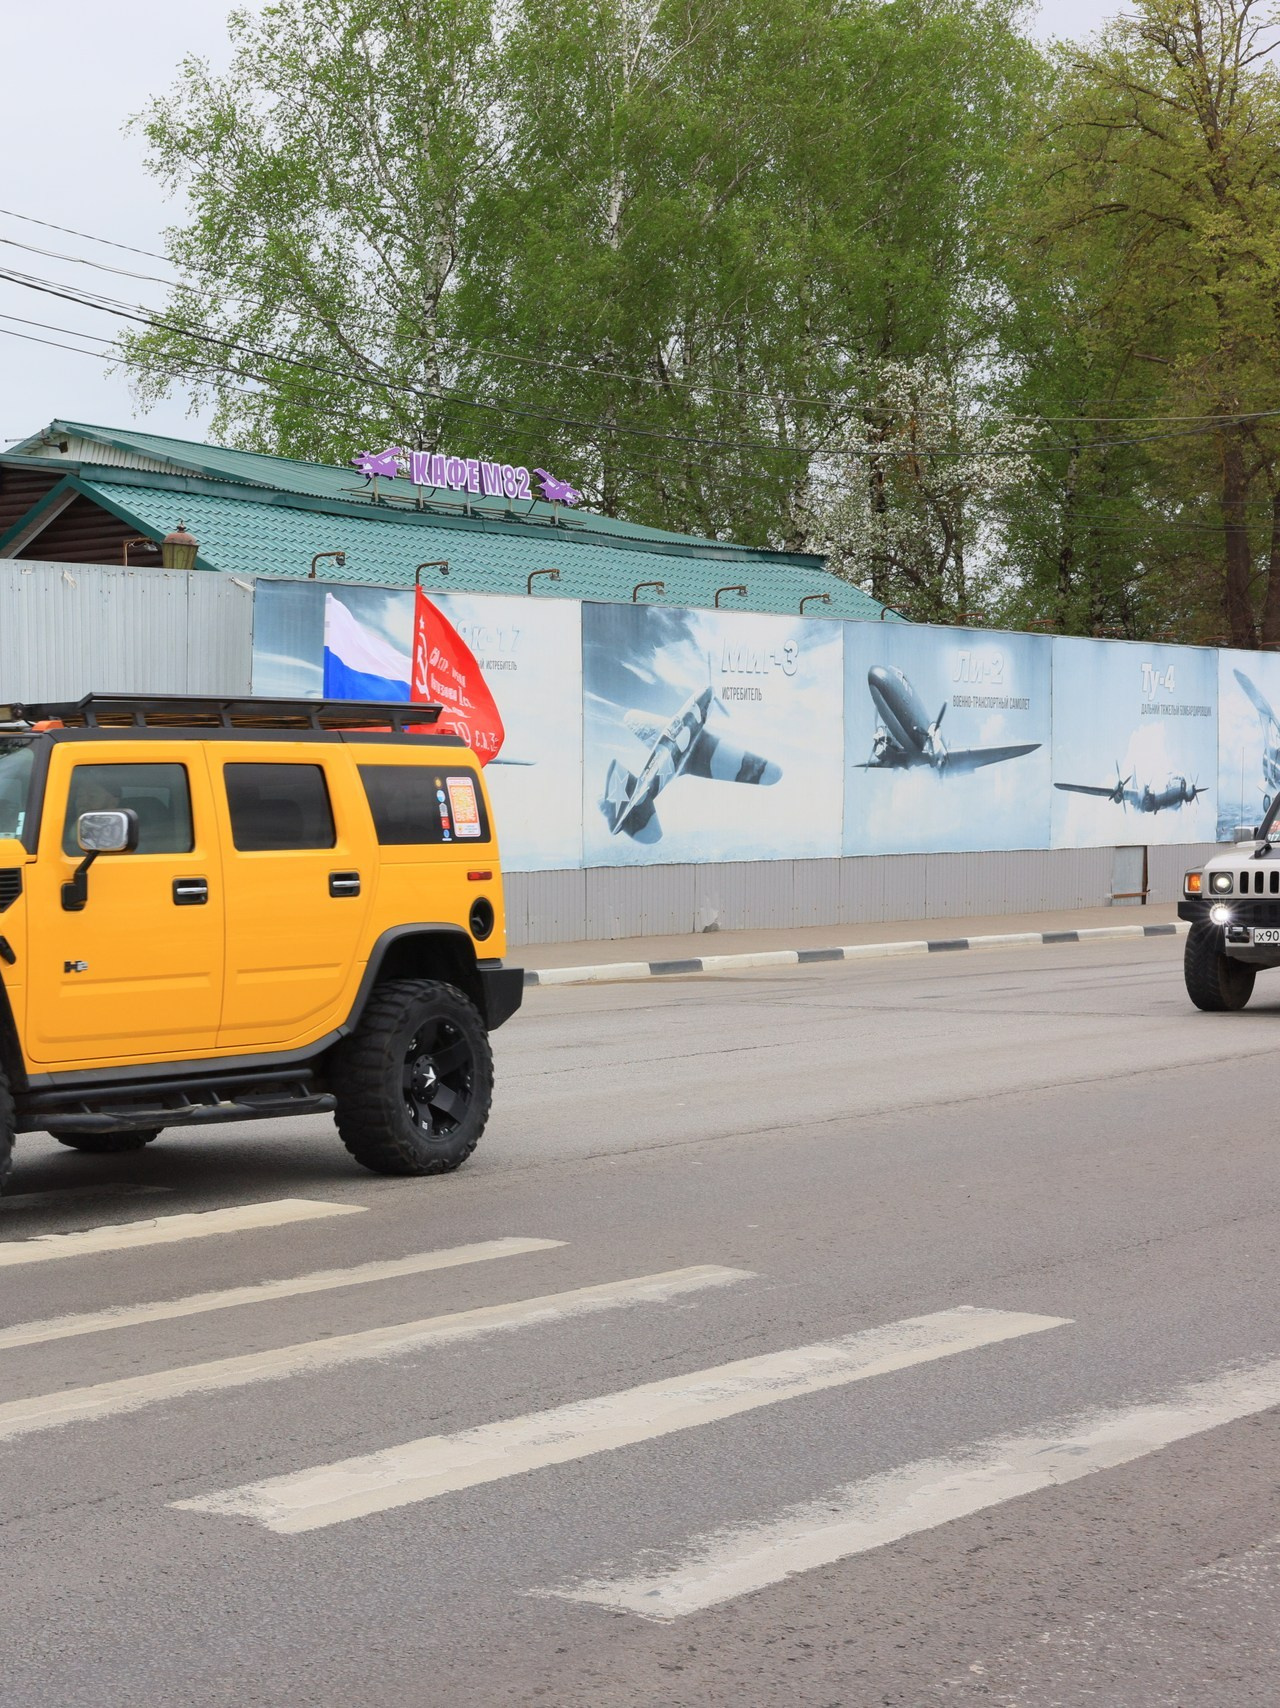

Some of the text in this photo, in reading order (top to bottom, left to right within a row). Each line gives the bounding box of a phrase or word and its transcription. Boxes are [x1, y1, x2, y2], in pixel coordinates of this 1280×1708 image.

[410, 450, 533, 500] КАФЕ М82
[486, 660, 519, 671] ИСТРЕБИТЕЛЬ
[953, 650, 1004, 685] Ли-2
[721, 686, 762, 702] ИСТРЕБИТЕЛЬ
[1141, 662, 1175, 701] Ту-4
[953, 694, 1008, 709] ВОЕННО-ТРАНСПОРТНЫЙ
